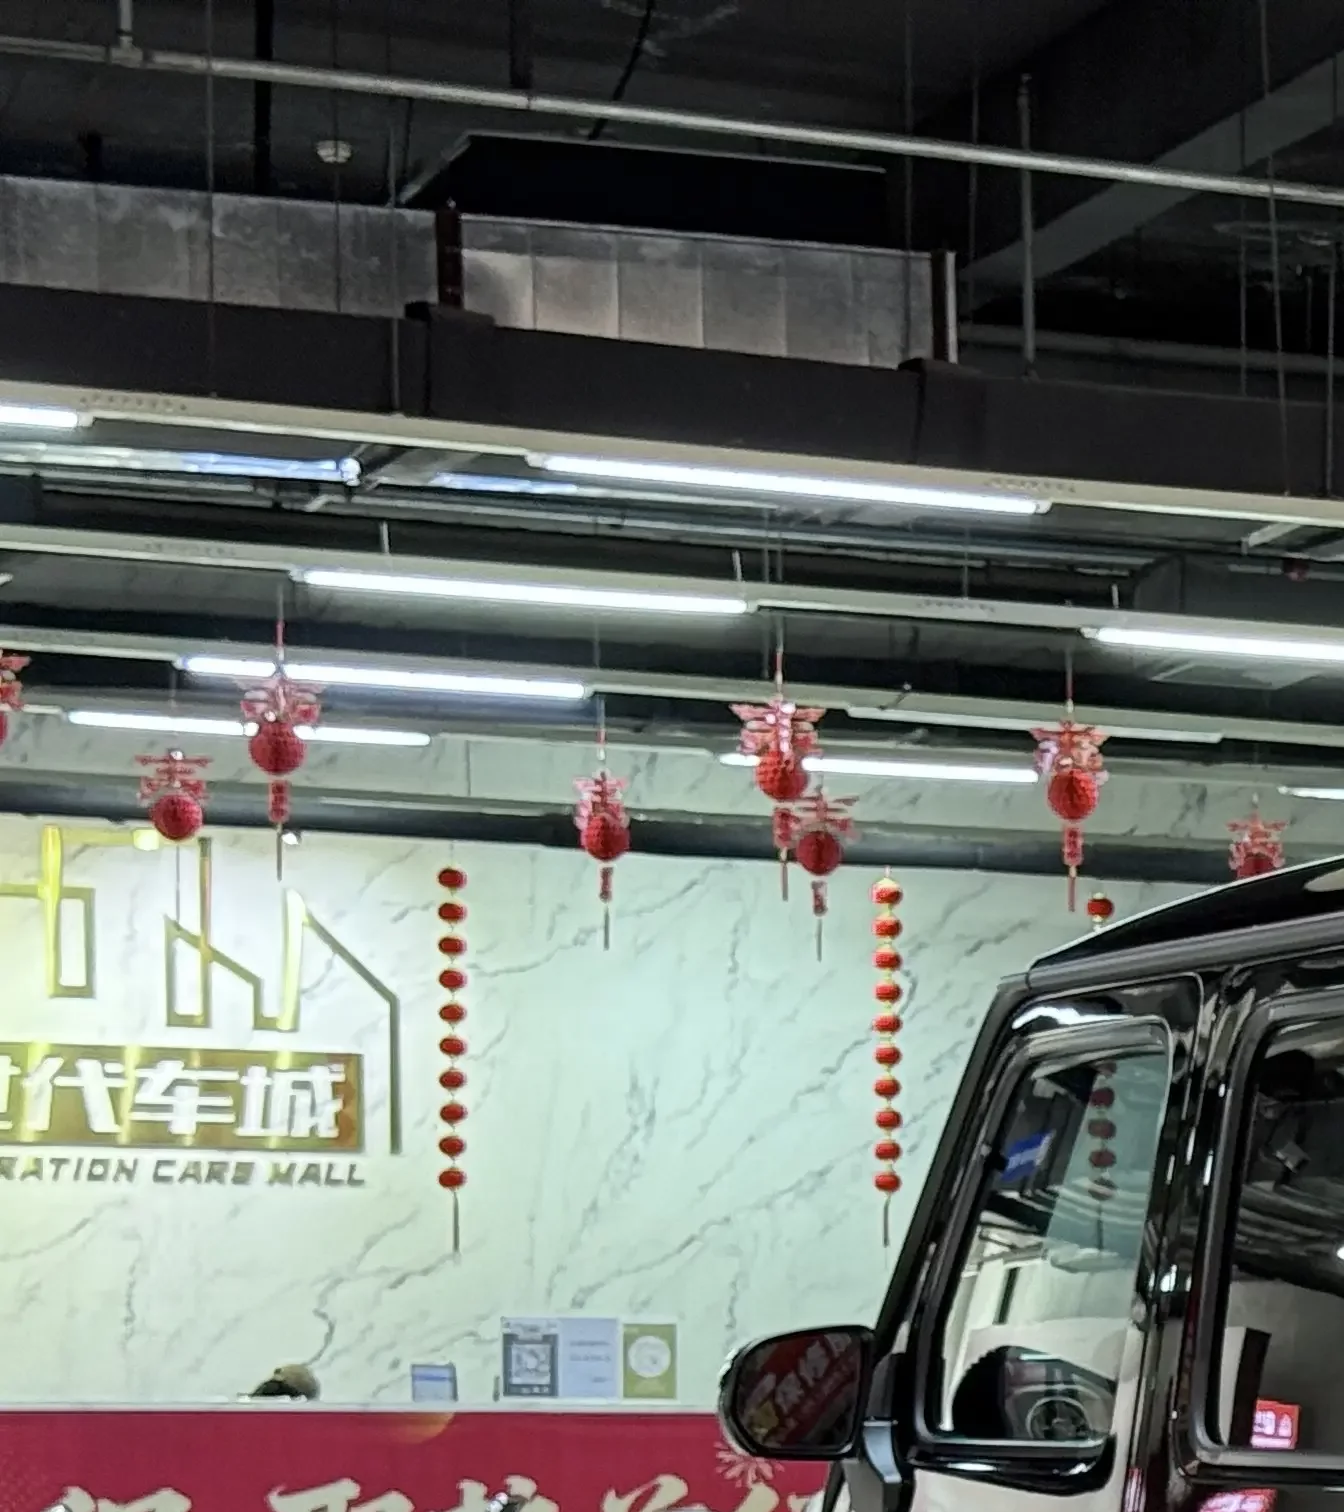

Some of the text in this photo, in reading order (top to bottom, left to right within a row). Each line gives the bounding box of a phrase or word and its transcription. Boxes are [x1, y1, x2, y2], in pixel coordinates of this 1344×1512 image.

[0, 1055, 346, 1138] 代车城
[152, 1160, 255, 1186] CARS
[268, 1162, 365, 1186] MALL
